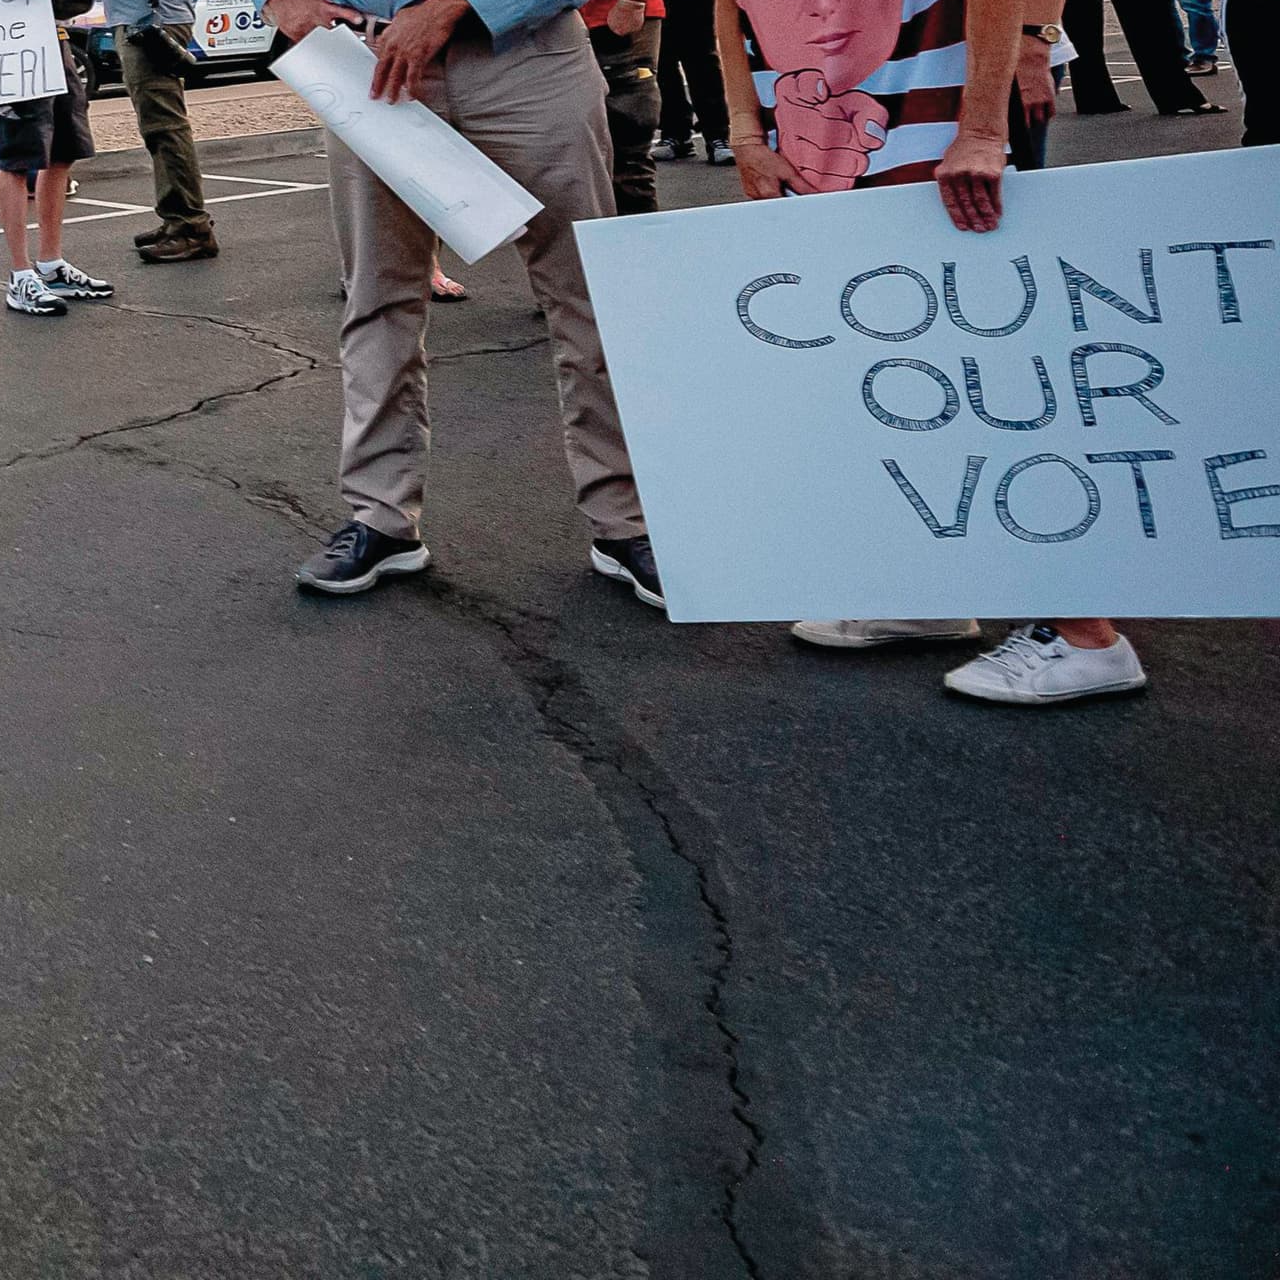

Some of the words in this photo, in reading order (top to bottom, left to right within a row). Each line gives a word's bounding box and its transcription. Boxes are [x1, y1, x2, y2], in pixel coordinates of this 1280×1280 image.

[736, 237, 1278, 350] COUNT
[861, 341, 1180, 432] OUR
[881, 447, 1280, 544] VOTE
